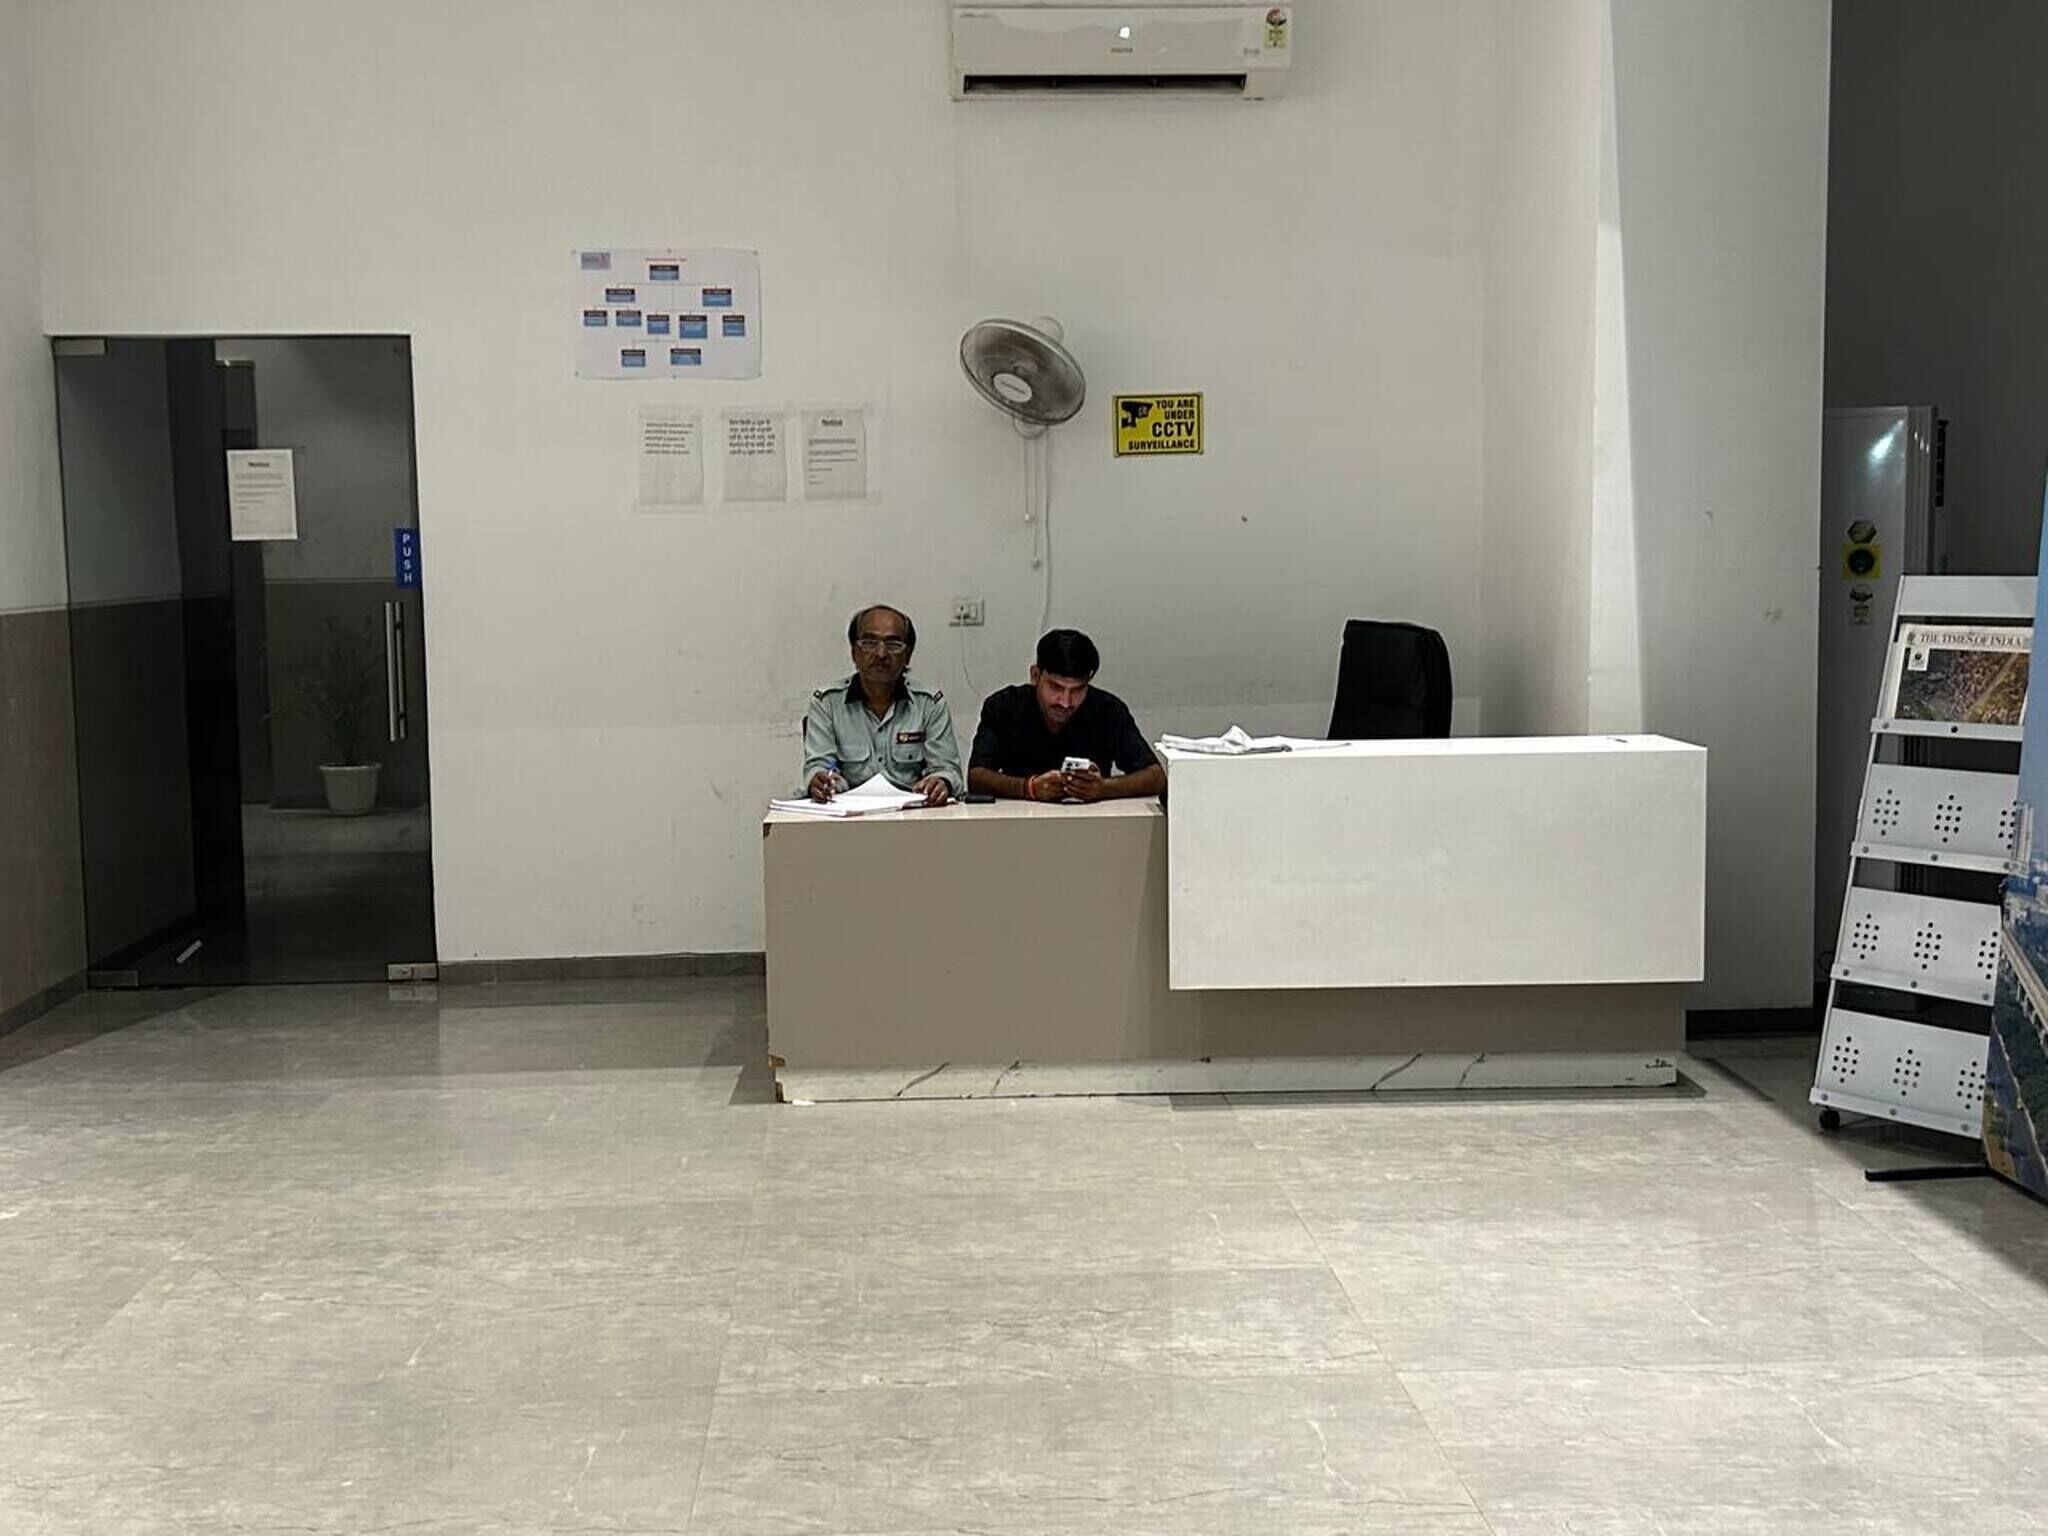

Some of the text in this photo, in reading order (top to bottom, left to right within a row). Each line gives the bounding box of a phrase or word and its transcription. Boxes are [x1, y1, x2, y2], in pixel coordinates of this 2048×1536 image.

[1156, 399, 1195, 409] YOU ARE
[1164, 409, 1195, 420] UNDER
[1152, 422, 1195, 437] CCTV
[1128, 440, 1195, 450] SURVEILLANCE
[401, 533, 413, 583] PUSH
[1920, 633, 2022, 646] THE TIMES OF INDIA
